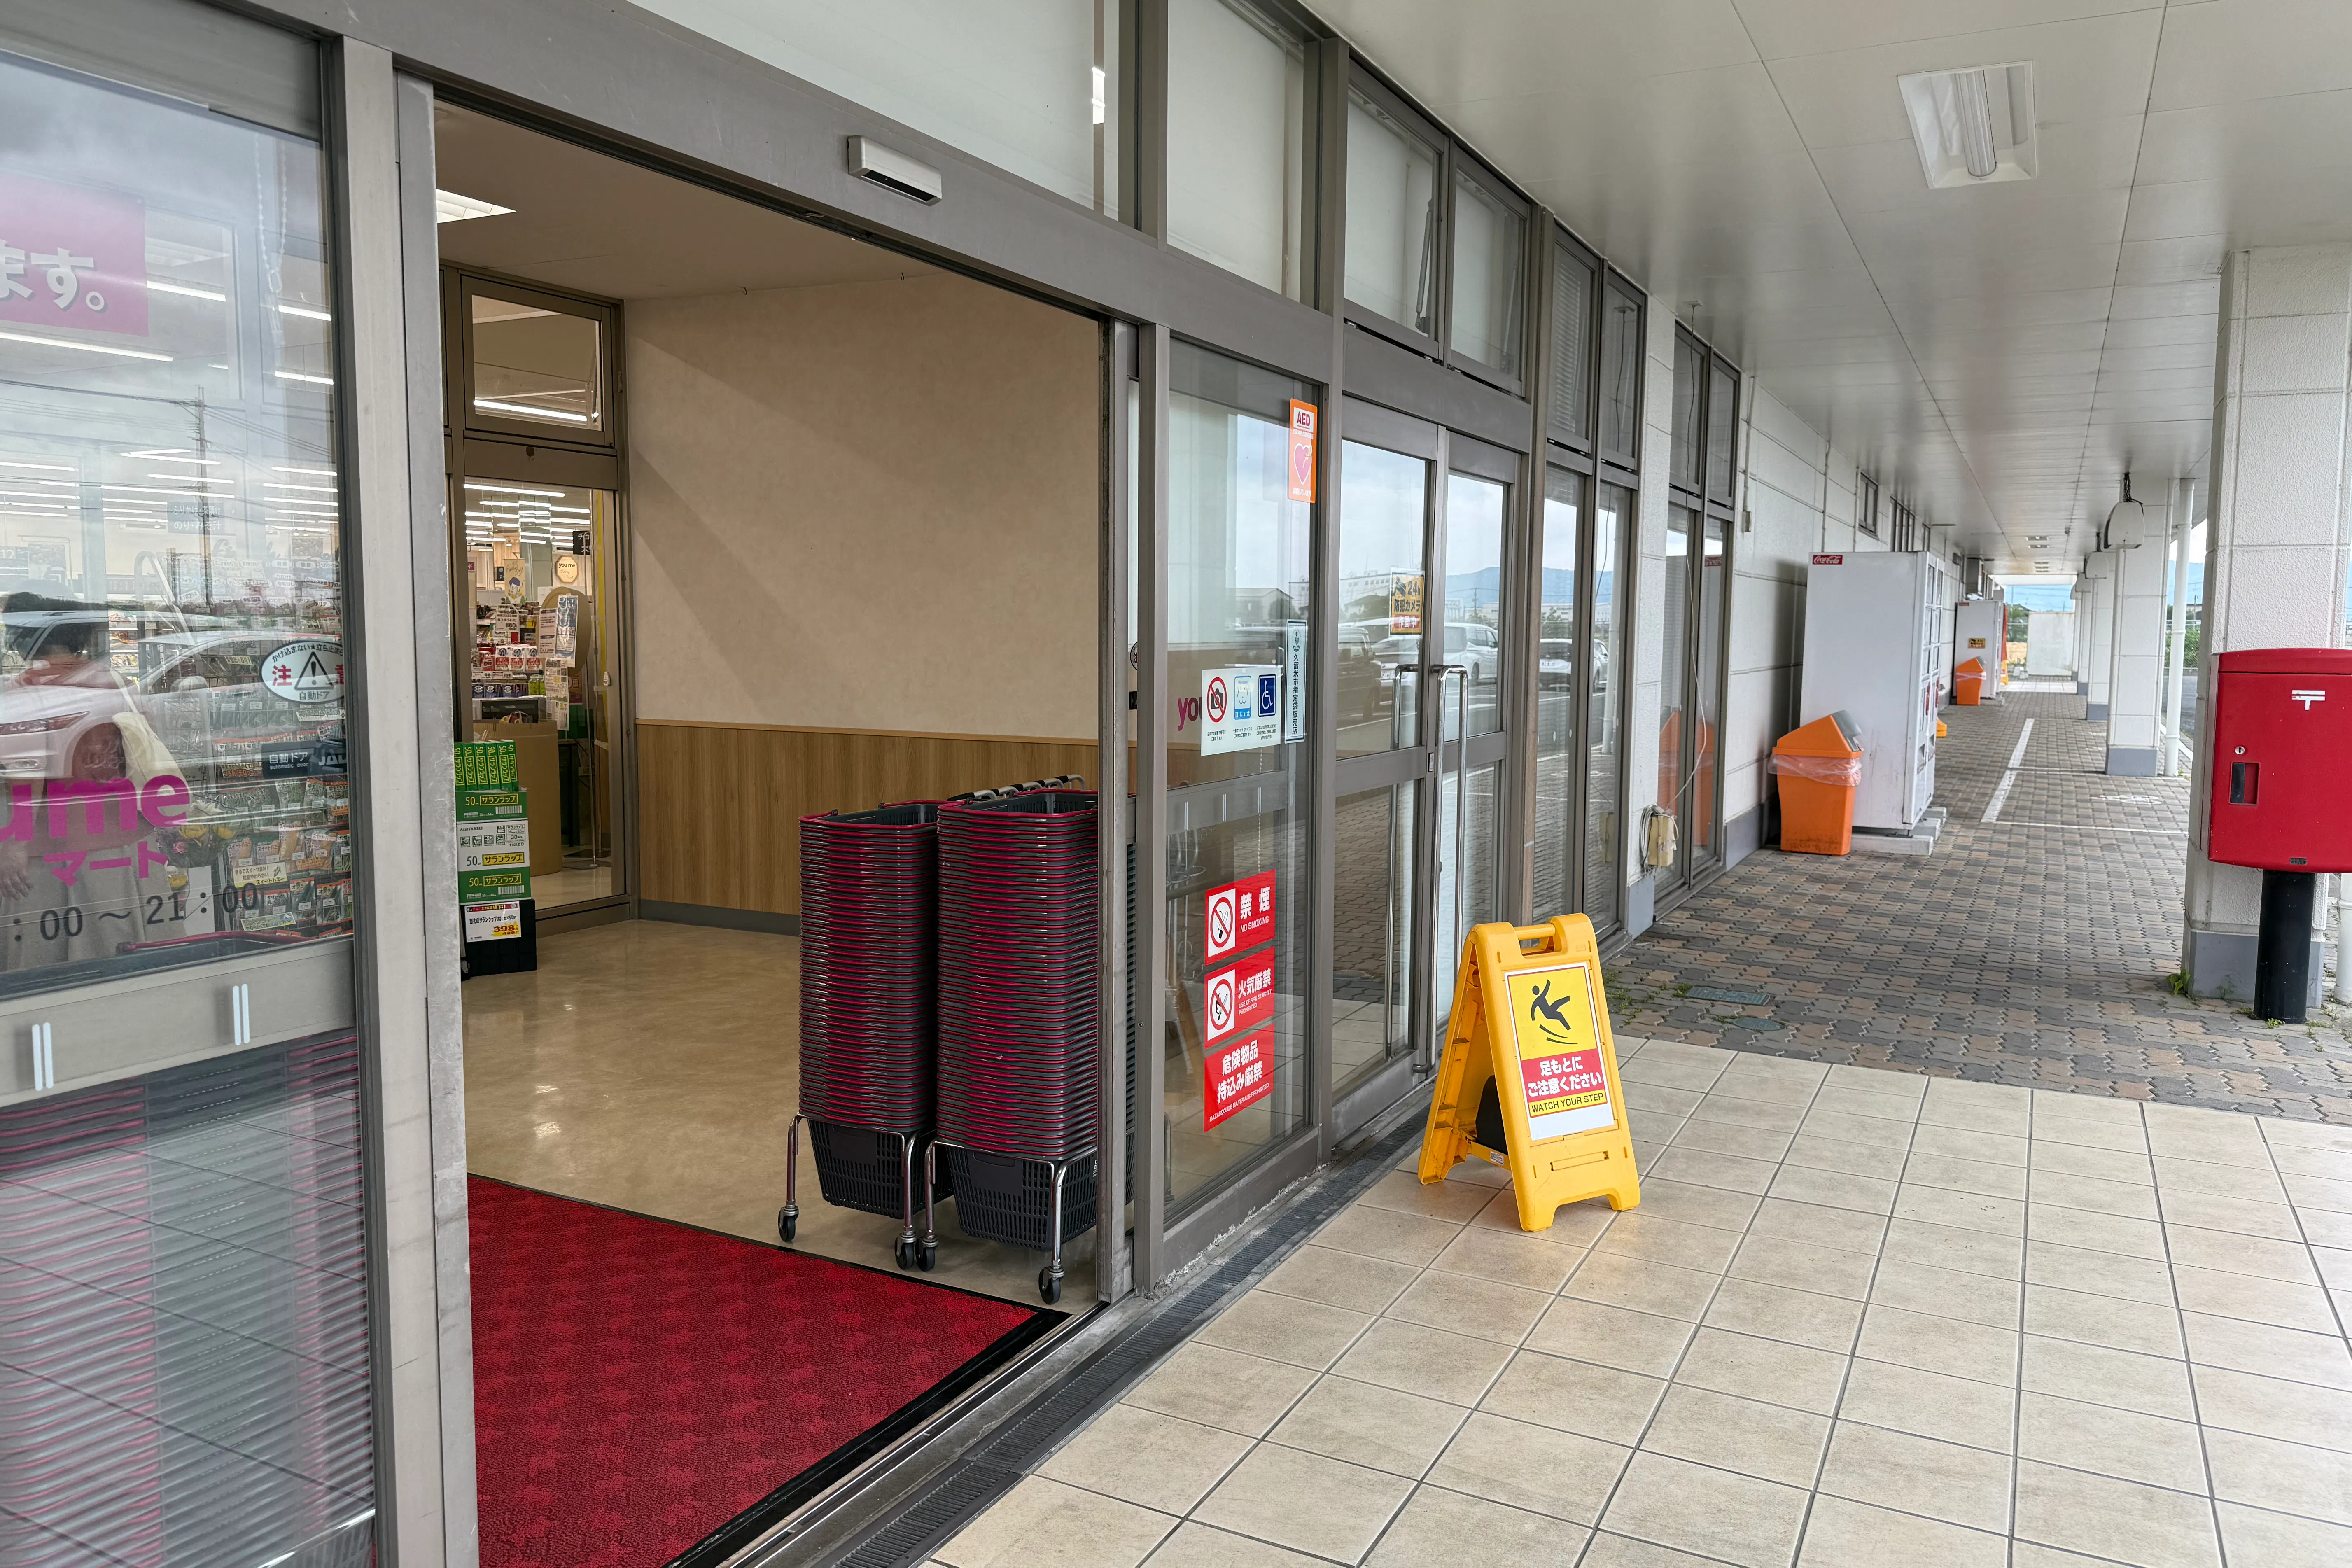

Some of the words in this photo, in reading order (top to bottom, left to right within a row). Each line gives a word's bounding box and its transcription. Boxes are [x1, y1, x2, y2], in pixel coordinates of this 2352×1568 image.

[1297, 411, 1310, 426] AED
[1407, 581, 1421, 596] 24h
[1394, 598, 1420, 612] 防犯カメラ
[299, 691, 330, 700] 自動ドア
[269, 751, 308, 764] 自動ドア
[481, 795, 516, 804] サランラップ
[44, 841, 169, 887] マート
[484, 854, 522, 864] サランラップ
[485, 875, 520, 884] サランラップ
[1240, 924, 1247, 933] NO
[1248, 915, 1269, 931] SMOKING
[1238, 968, 1271, 999] 火気厳禁
[1257, 989, 1272, 1001] STRICTLY
[1238, 1002, 1257, 1016] PROHIBITED
[1222, 1040, 1258, 1076] 危険物品
[1540, 1056, 1583, 1077] 足もとに
[1217, 1060, 1262, 1104] 持込み厳禁
[1528, 1072, 1602, 1097] ご注意ください
[1209, 1104, 1233, 1122] HAZARDOUSE
[1233, 1093, 1251, 1109] MATERIALS
[1251, 1083, 1269, 1098] PROHIBITED
[1532, 1101, 1559, 1113] WATCH
[1561, 1097, 1582, 1107] YOUR
[1584, 1093, 1603, 1103] STEP
